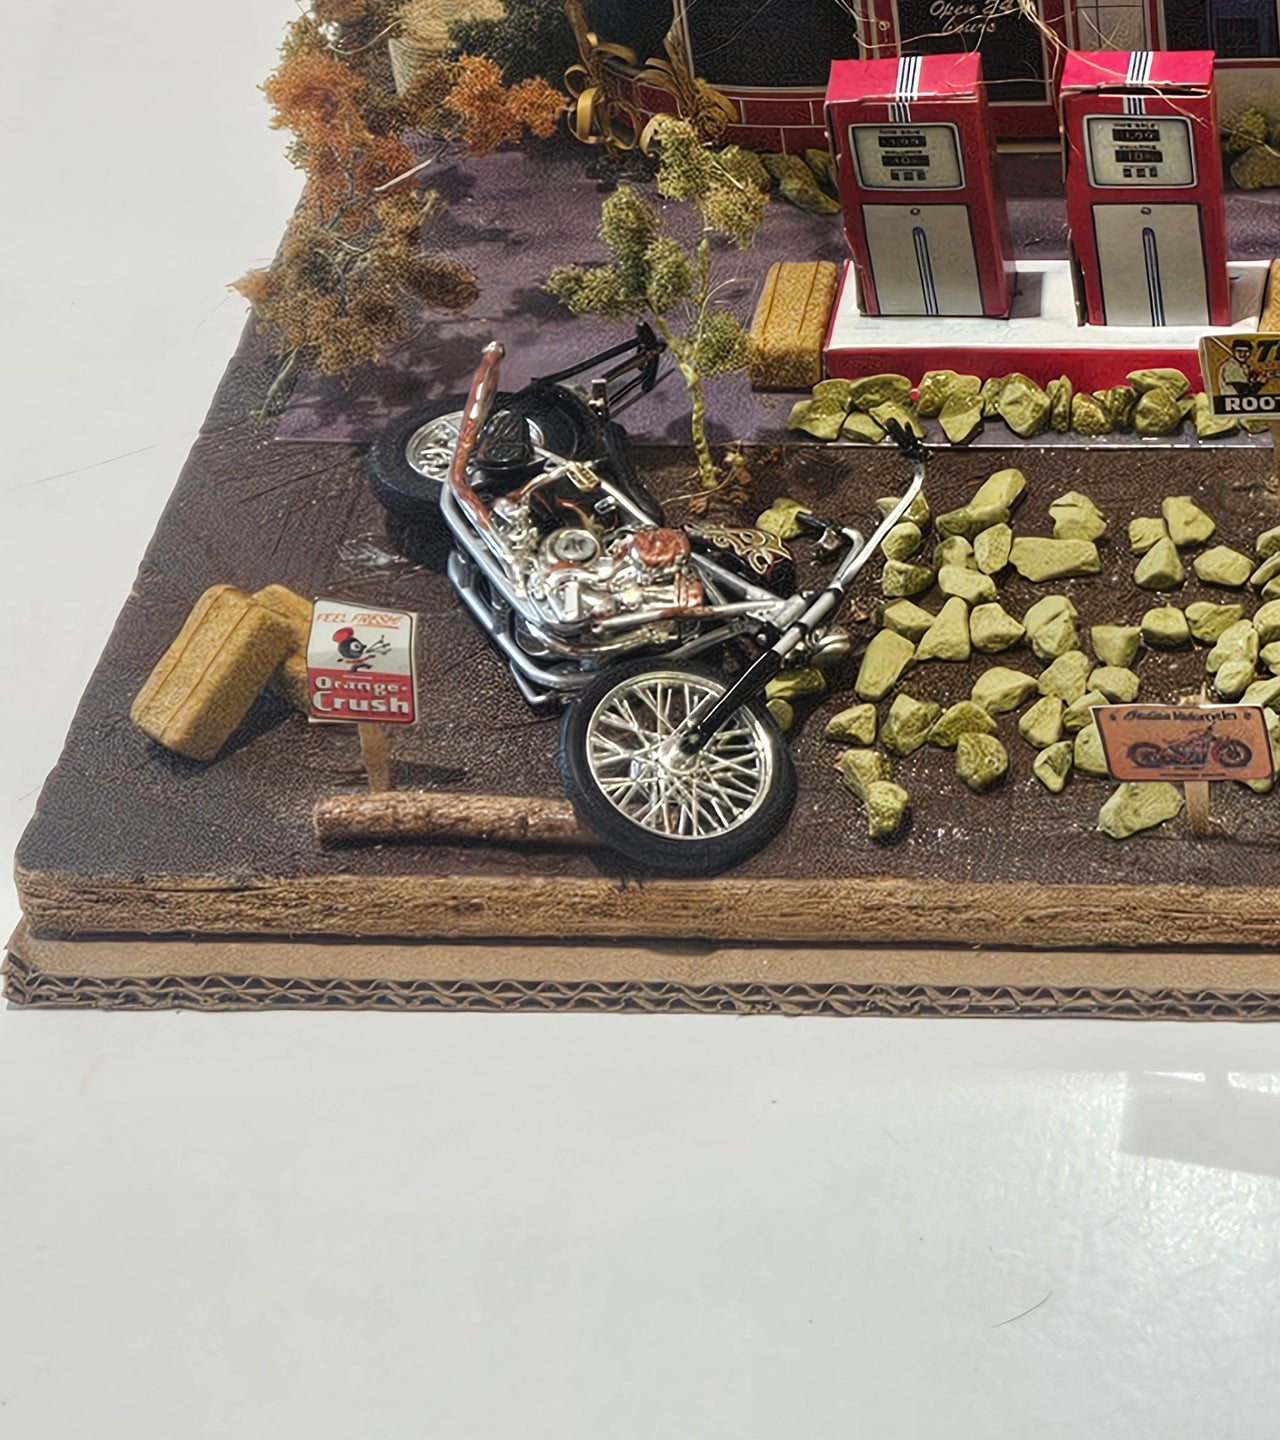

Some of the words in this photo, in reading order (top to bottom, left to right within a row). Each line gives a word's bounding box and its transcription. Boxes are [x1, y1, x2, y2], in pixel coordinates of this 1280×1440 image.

[930, 0, 976, 19] Open
[316, 612, 347, 623] FEEL
[312, 690, 409, 713] Crush
